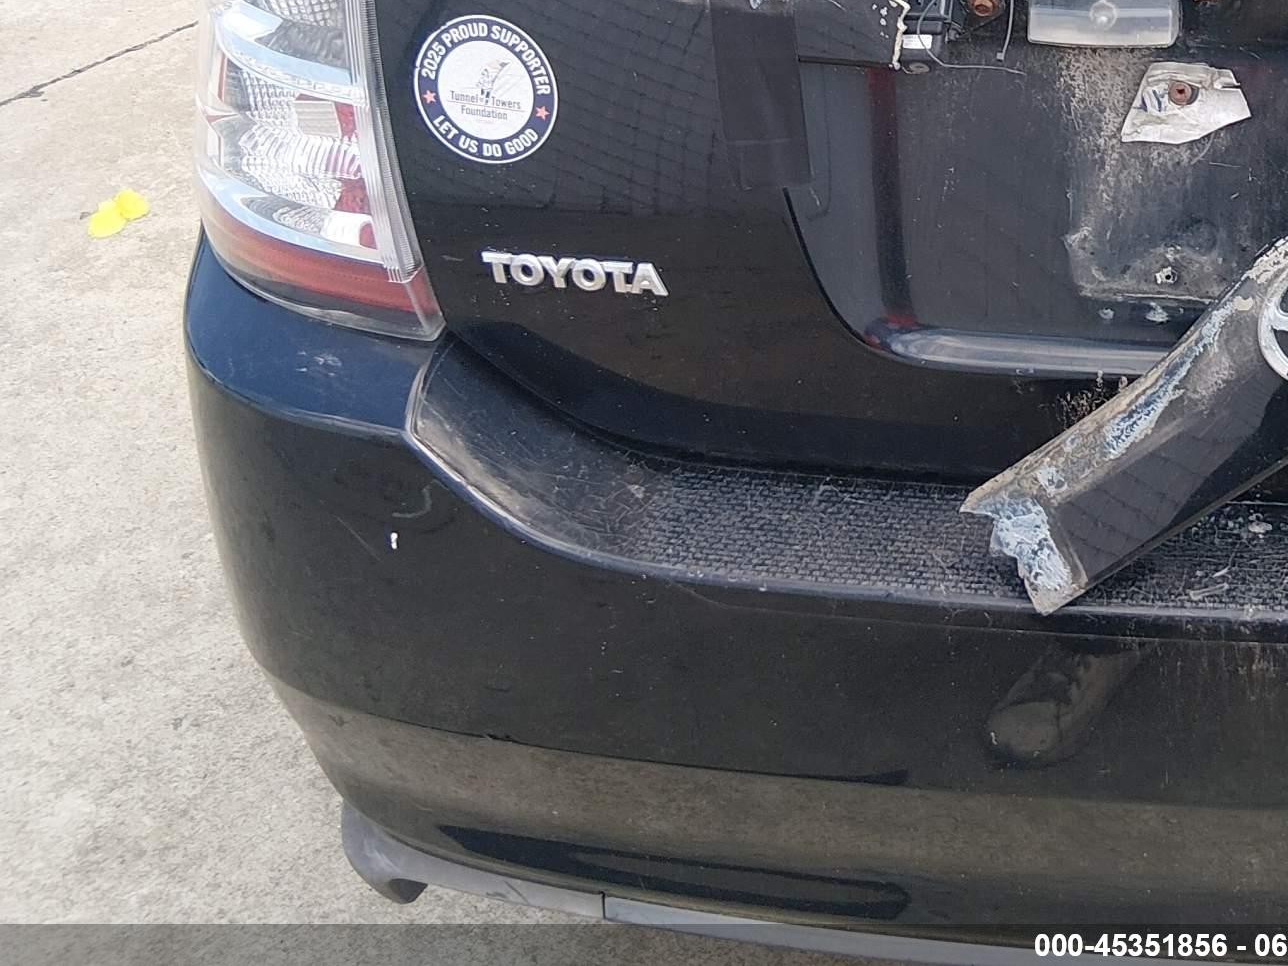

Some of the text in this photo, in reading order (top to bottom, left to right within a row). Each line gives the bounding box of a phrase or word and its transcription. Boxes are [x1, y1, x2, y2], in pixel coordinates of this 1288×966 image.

[422, 22, 551, 95] 2025 PROUD SUPPORTER
[450, 90, 522, 110] Tunnel Towers
[461, 105, 508, 121] Foundation
[433, 115, 539, 157] LET US DO GOOD
[481, 251, 669, 297] TOYOTA
